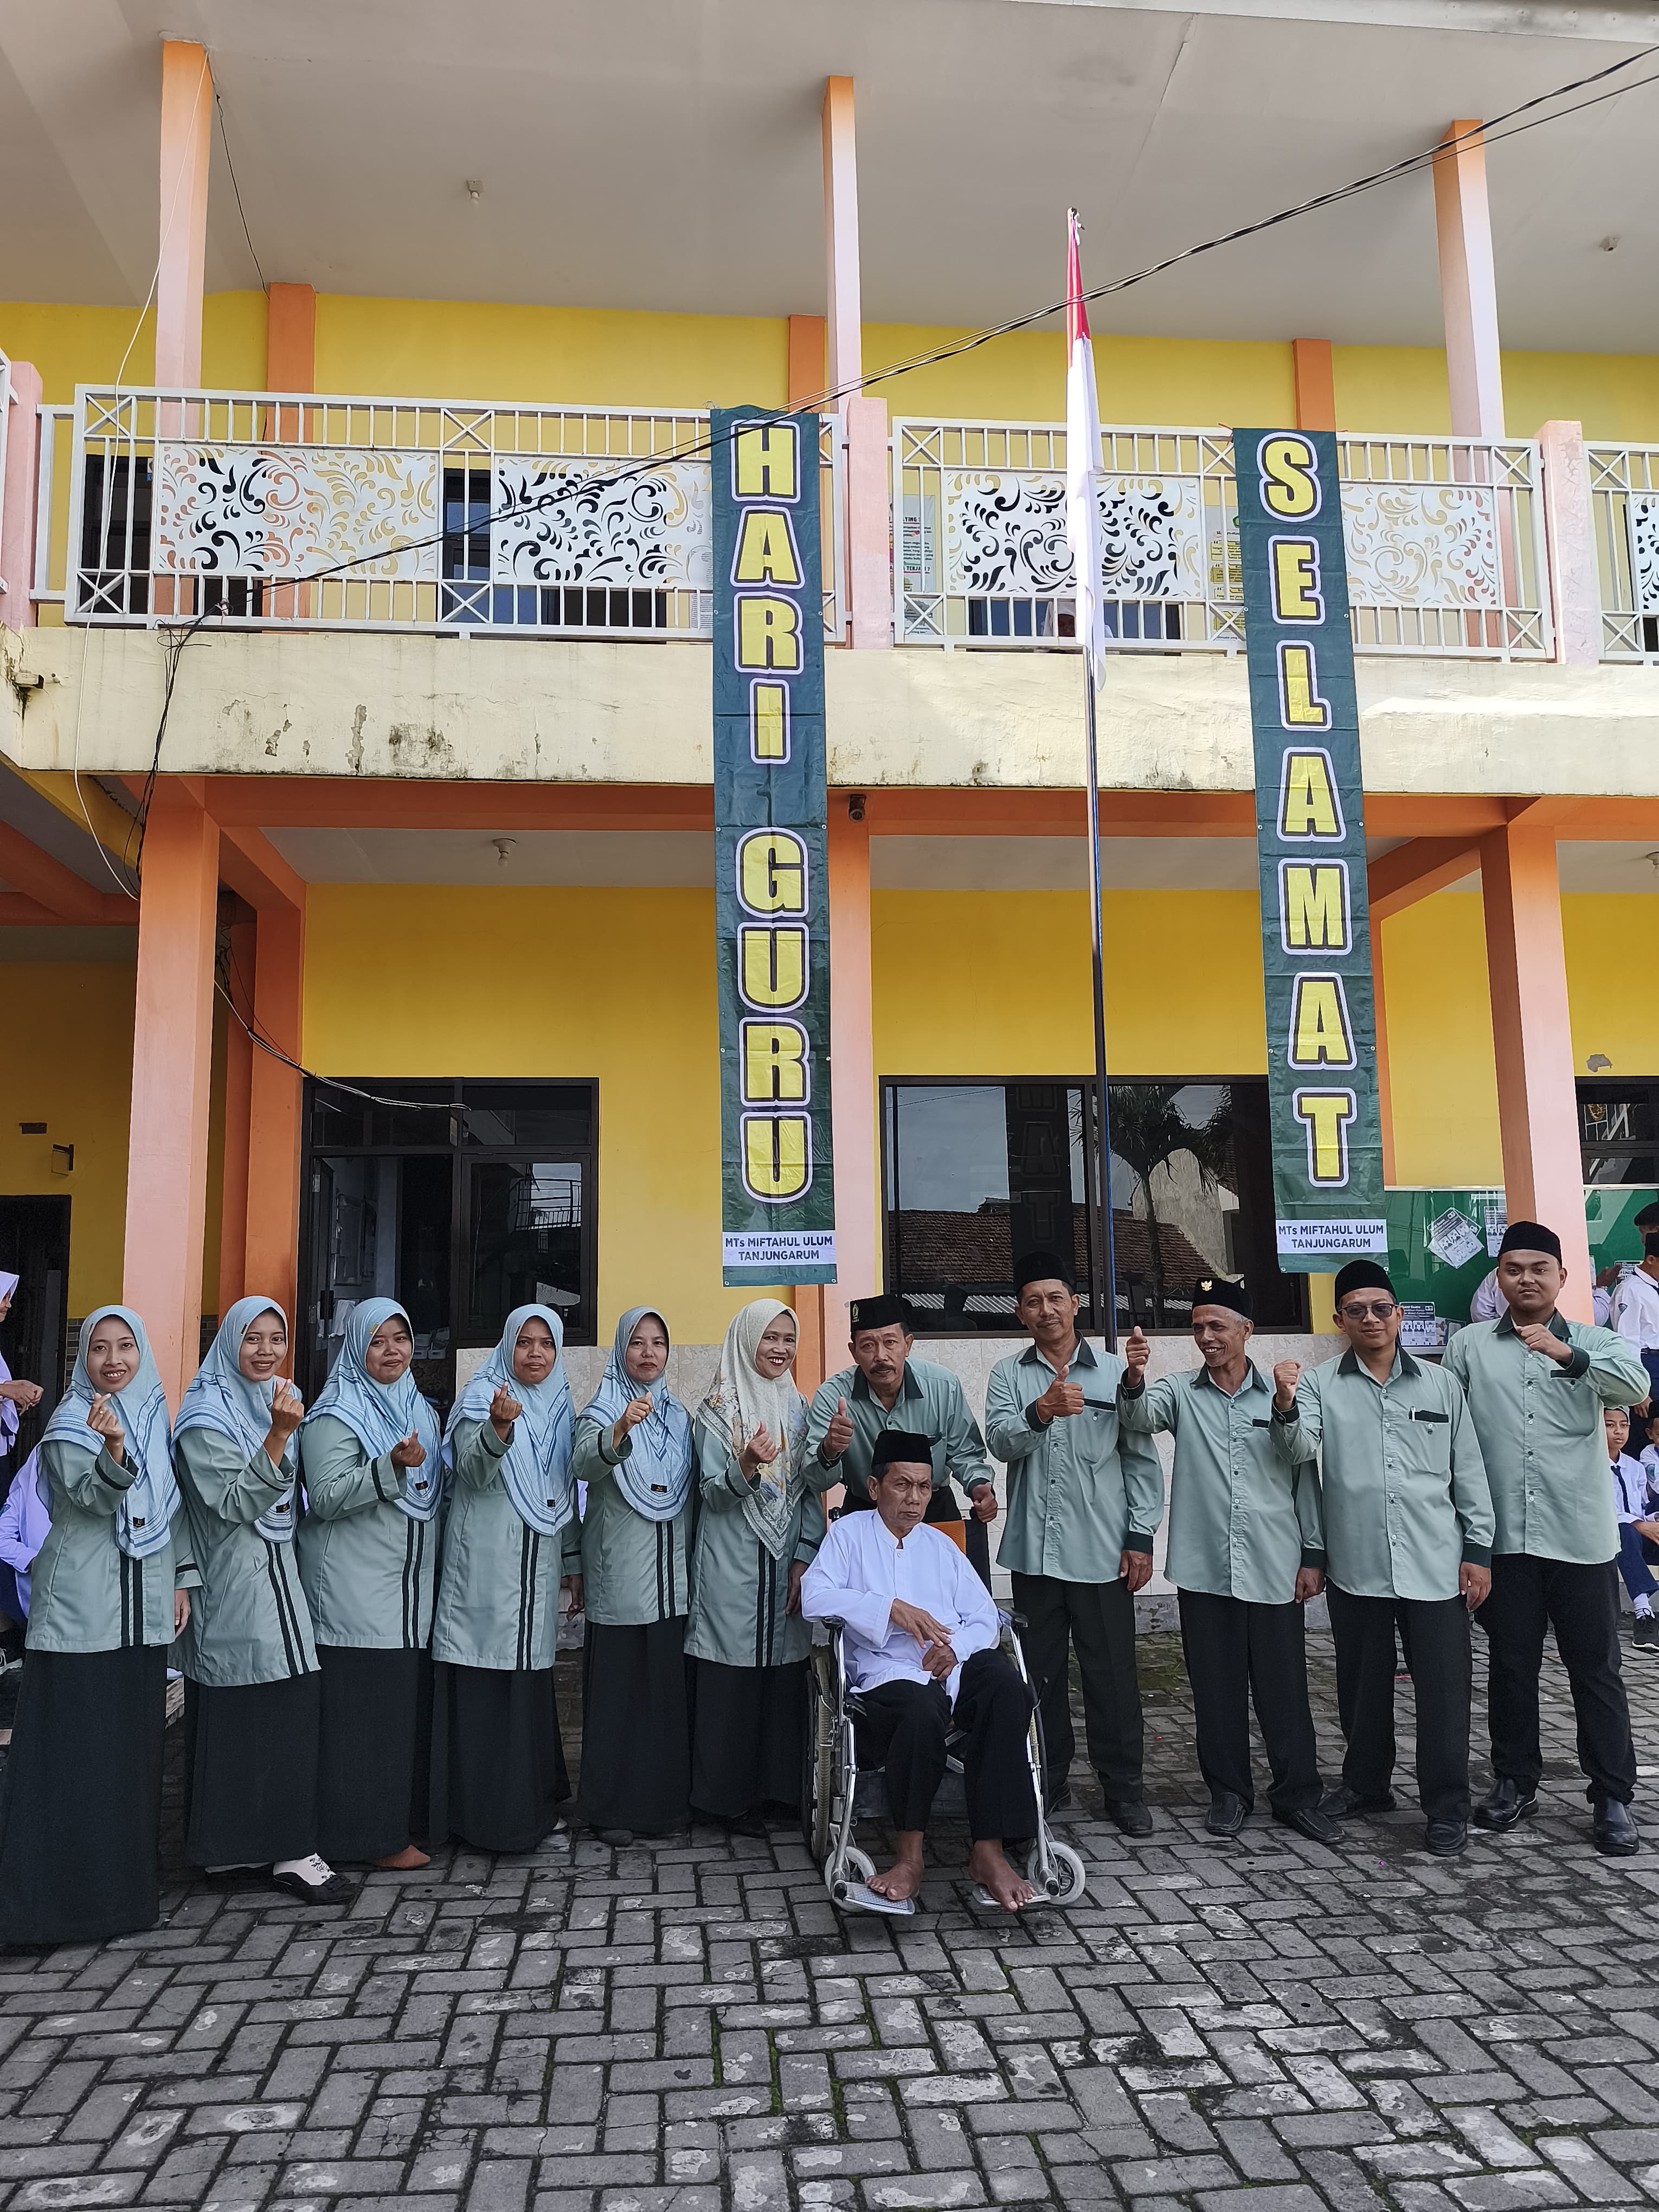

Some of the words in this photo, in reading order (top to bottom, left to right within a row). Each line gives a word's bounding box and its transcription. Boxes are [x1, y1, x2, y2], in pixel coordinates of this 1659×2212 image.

[730, 420, 805, 765] HARI
[1256, 432, 1357, 1187] SELAMAT
[736, 826, 813, 1204] GURU
[1278, 1226, 1297, 1235] MTs
[1300, 1225, 1353, 1235] MIFTAHUL
[1355, 1225, 1384, 1234] ULUM
[725, 1238, 745, 1248] MTs
[748, 1237, 800, 1247] MIFTAHUL
[803, 1236, 833, 1246] ULUM
[1291, 1238, 1371, 1249] TANJUNGARUM
[738, 1250, 820, 1261] TANJUNGARUM
